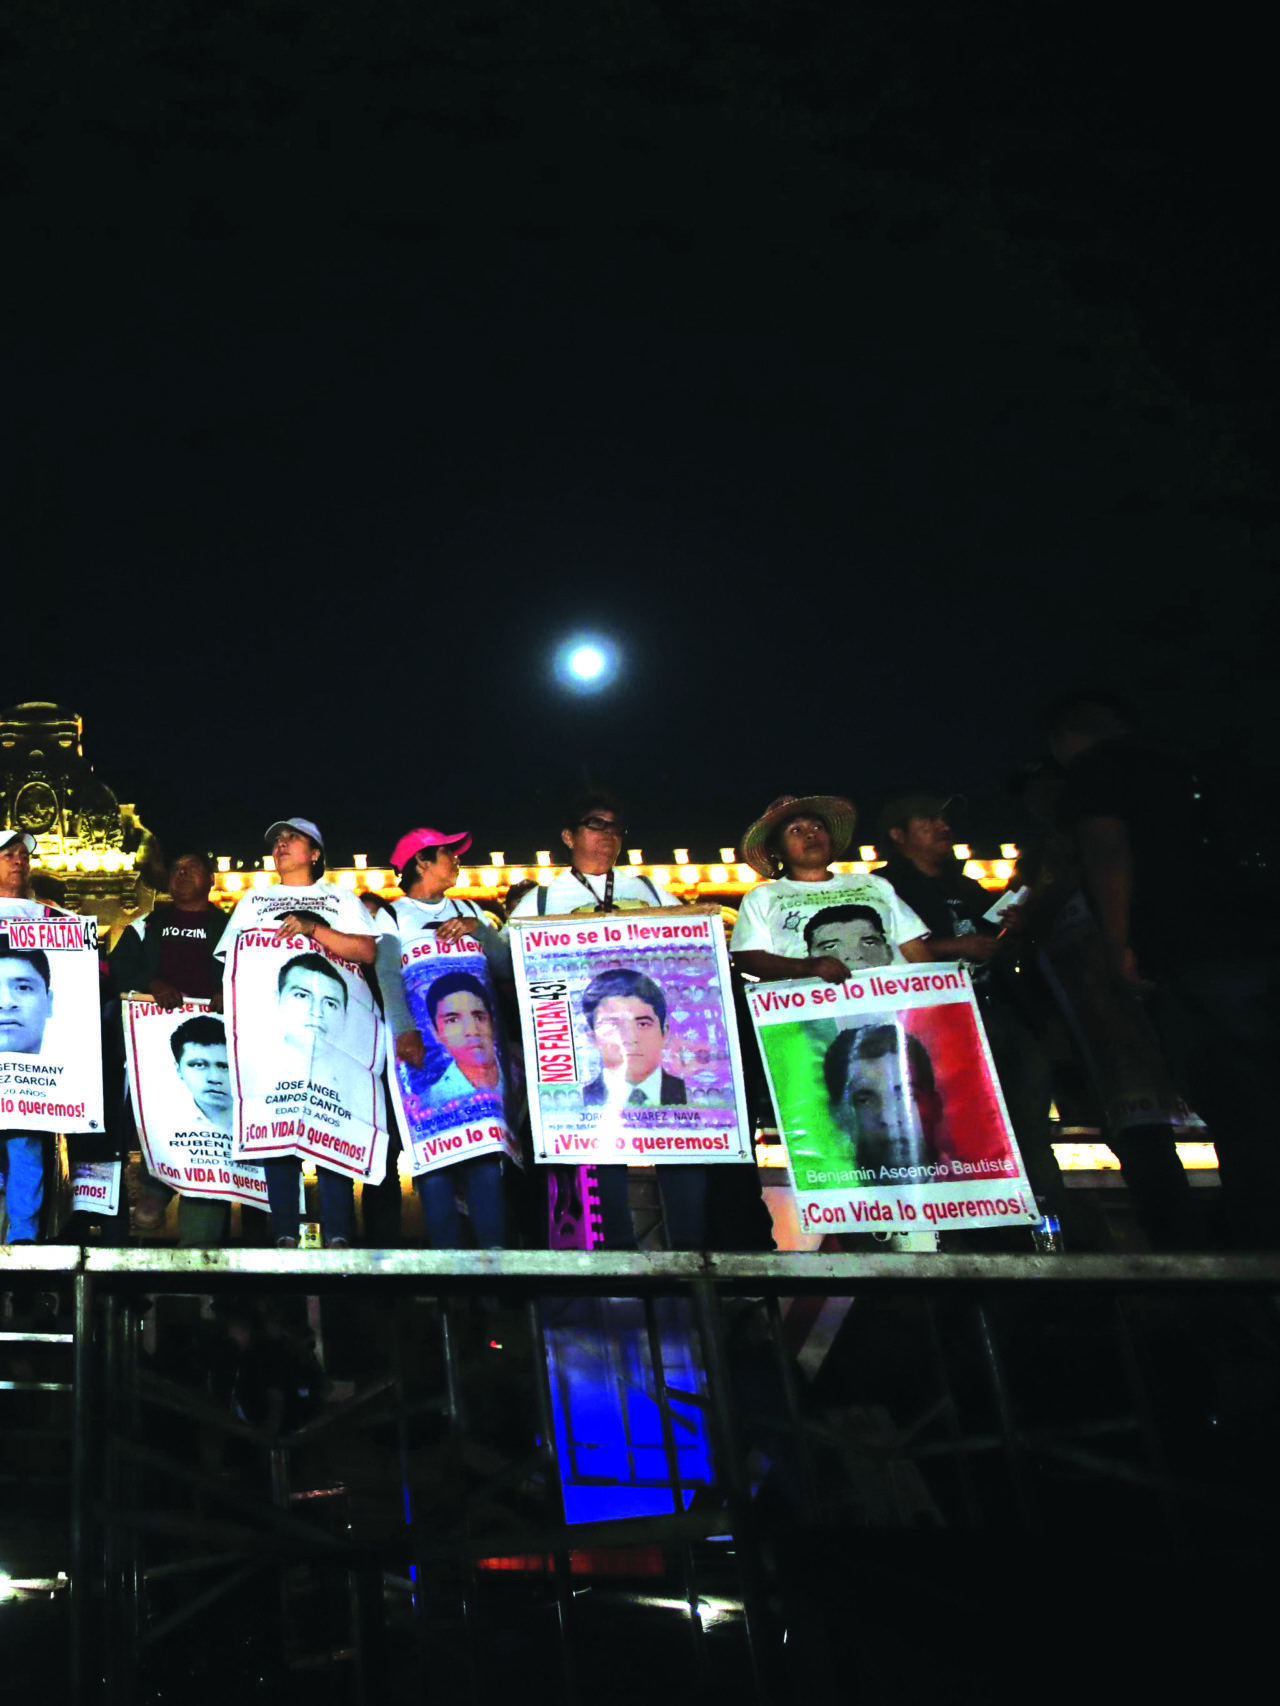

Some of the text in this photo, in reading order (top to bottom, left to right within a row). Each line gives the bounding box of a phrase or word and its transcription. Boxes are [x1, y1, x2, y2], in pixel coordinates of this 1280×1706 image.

[9, 925, 36, 948] NOS
[39, 923, 84, 949] FALTAN
[239, 933, 281, 950] ¡Vivo
[286, 936, 304, 950] se
[525, 921, 710, 951] ¡Vivo se lo llevaron!
[412, 943, 431, 958] se
[436, 941, 451, 954] lo
[529, 979, 567, 1000] 43!
[752, 969, 967, 1018] ¡Vivo se lo llevaron!
[178, 1003, 194, 1014] se
[535, 1000, 571, 1051] FALTAN
[540, 1054, 573, 1083] NOS
[19, 1087, 47, 1098] AÑOS
[1, 1098, 14, 1113] lo
[18, 1099, 85, 1118] queremos!
[265, 1092, 352, 1120] CAMPOS CANTOR
[275, 1106, 300, 1115] EDAD
[314, 1112, 341, 1128] AÑOS
[674, 1112, 701, 1121] NAVA
[246, 1119, 367, 1163] ¡Con VIDA lo queremos!
[422, 1135, 462, 1162] ¡Vivo
[465, 1128, 483, 1144] lo
[632, 1132, 730, 1154] queremos!
[190, 1158, 220, 1166] EDAD
[880, 1161, 949, 1179] Ascencio
[952, 1157, 1015, 1176] Bautista
[184, 1167, 216, 1183] VIDA
[219, 1168, 231, 1184] lo
[801, 1191, 1028, 1227] ¡Con Vida lo queremos!
